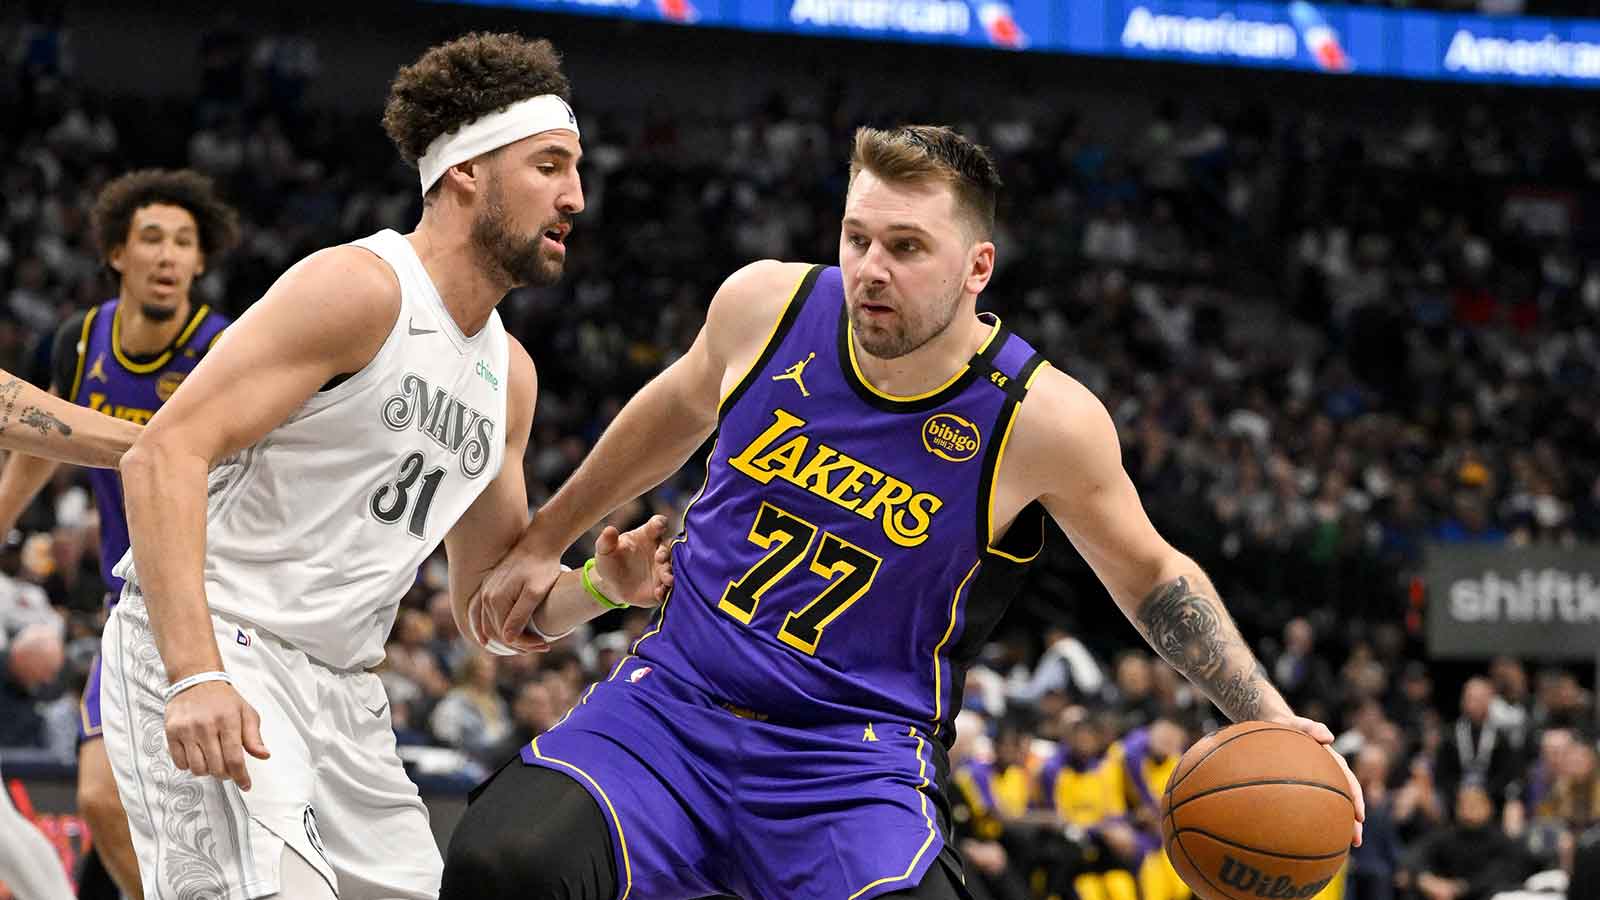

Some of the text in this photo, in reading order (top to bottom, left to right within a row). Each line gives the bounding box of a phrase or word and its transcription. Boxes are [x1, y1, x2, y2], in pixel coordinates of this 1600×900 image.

[1120, 6, 1297, 60] American
[990, 371, 1009, 387] 44
[381, 371, 495, 480] MAVS
[928, 420, 977, 452] bibigo
[369, 450, 448, 541] 31
[727, 407, 945, 548] LAKERS
[717, 500, 884, 657] 77
